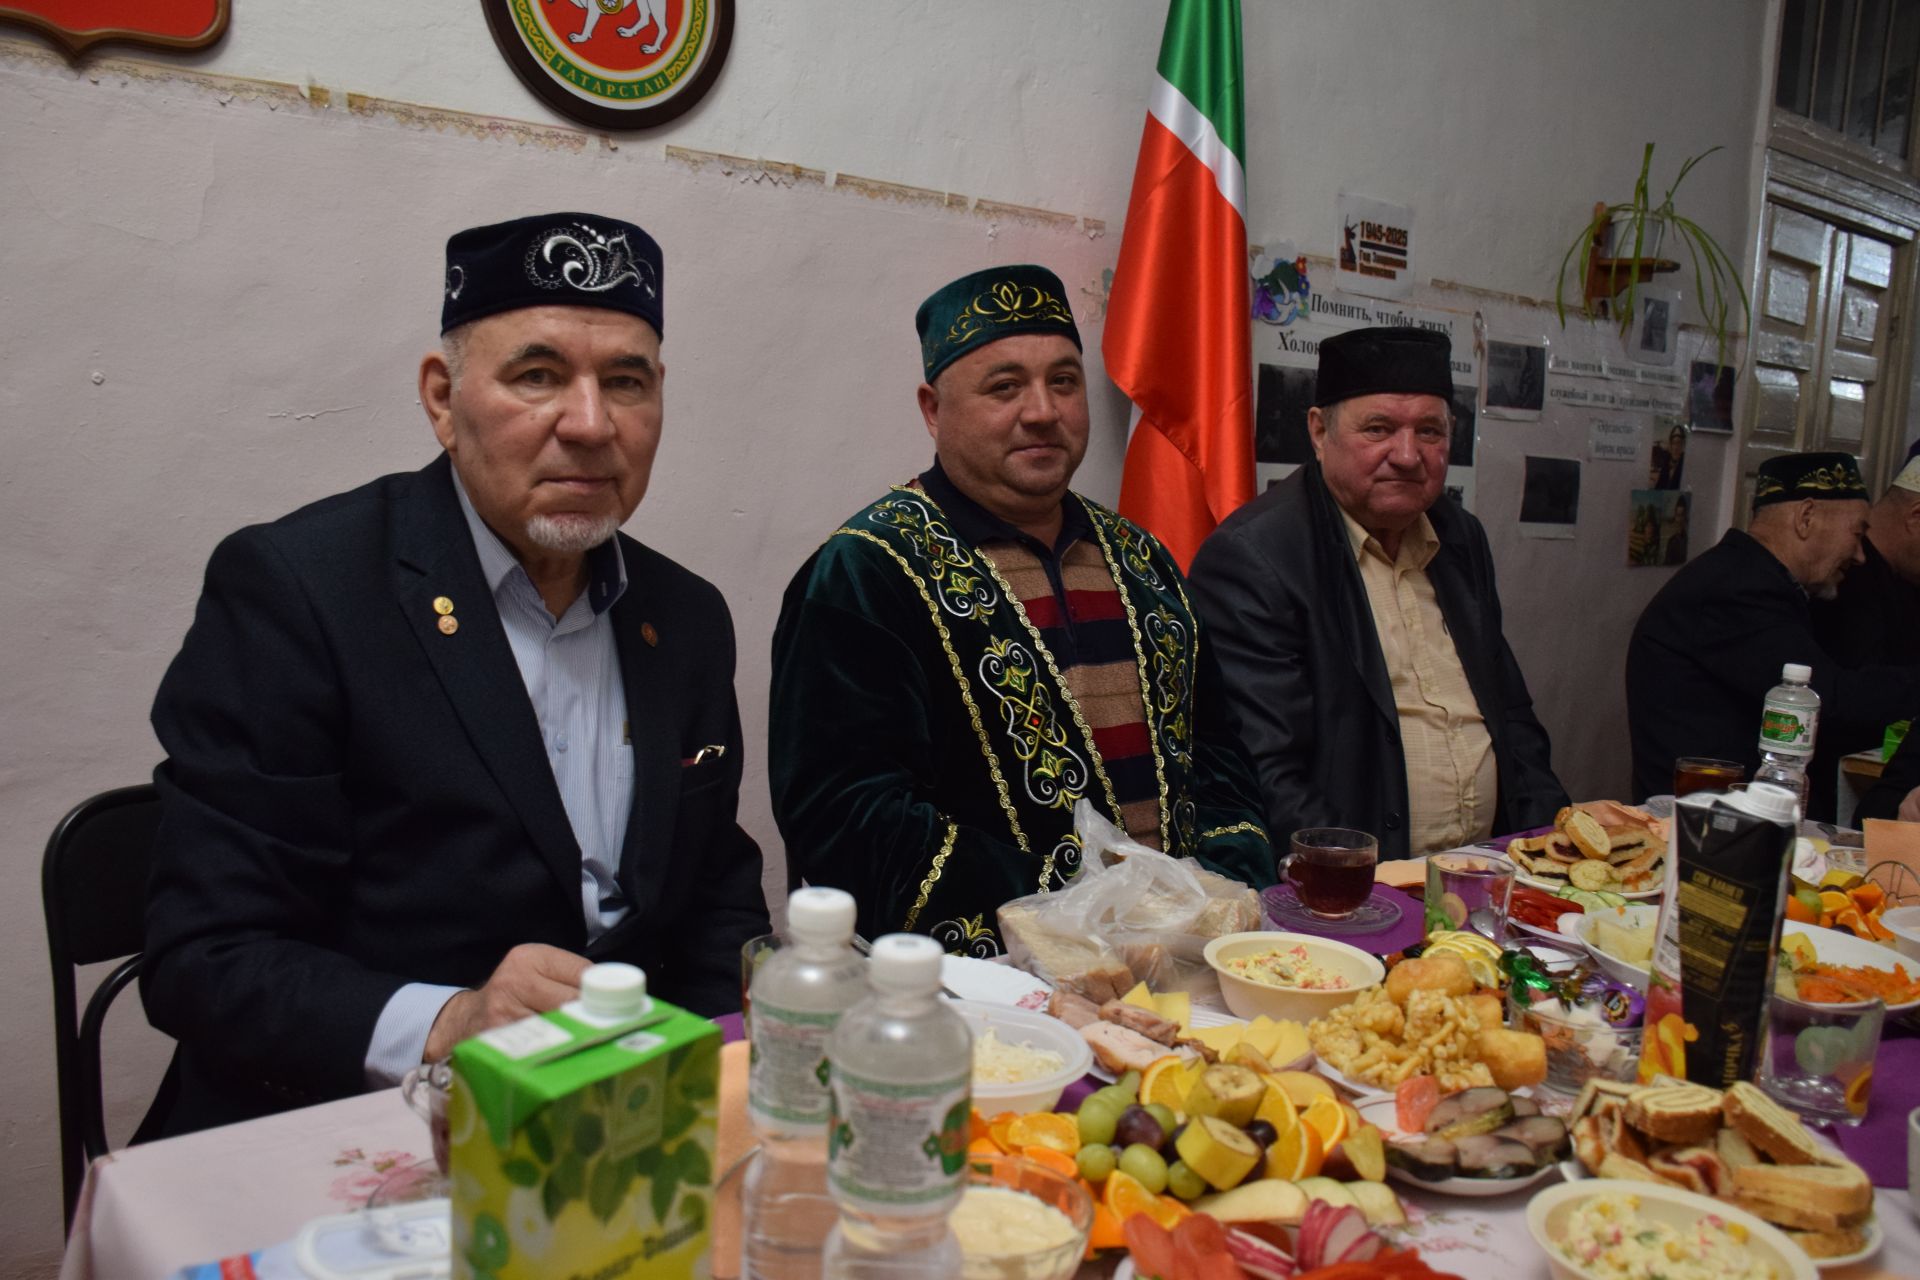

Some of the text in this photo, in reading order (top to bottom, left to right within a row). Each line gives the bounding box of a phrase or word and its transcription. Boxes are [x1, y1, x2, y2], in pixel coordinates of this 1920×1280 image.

[556, 61, 666, 97] ТАТАРСТАН
[1360, 220, 1408, 247] 1945-2025
[1311, 293, 1453, 337] Помнить, чтобы жить!
